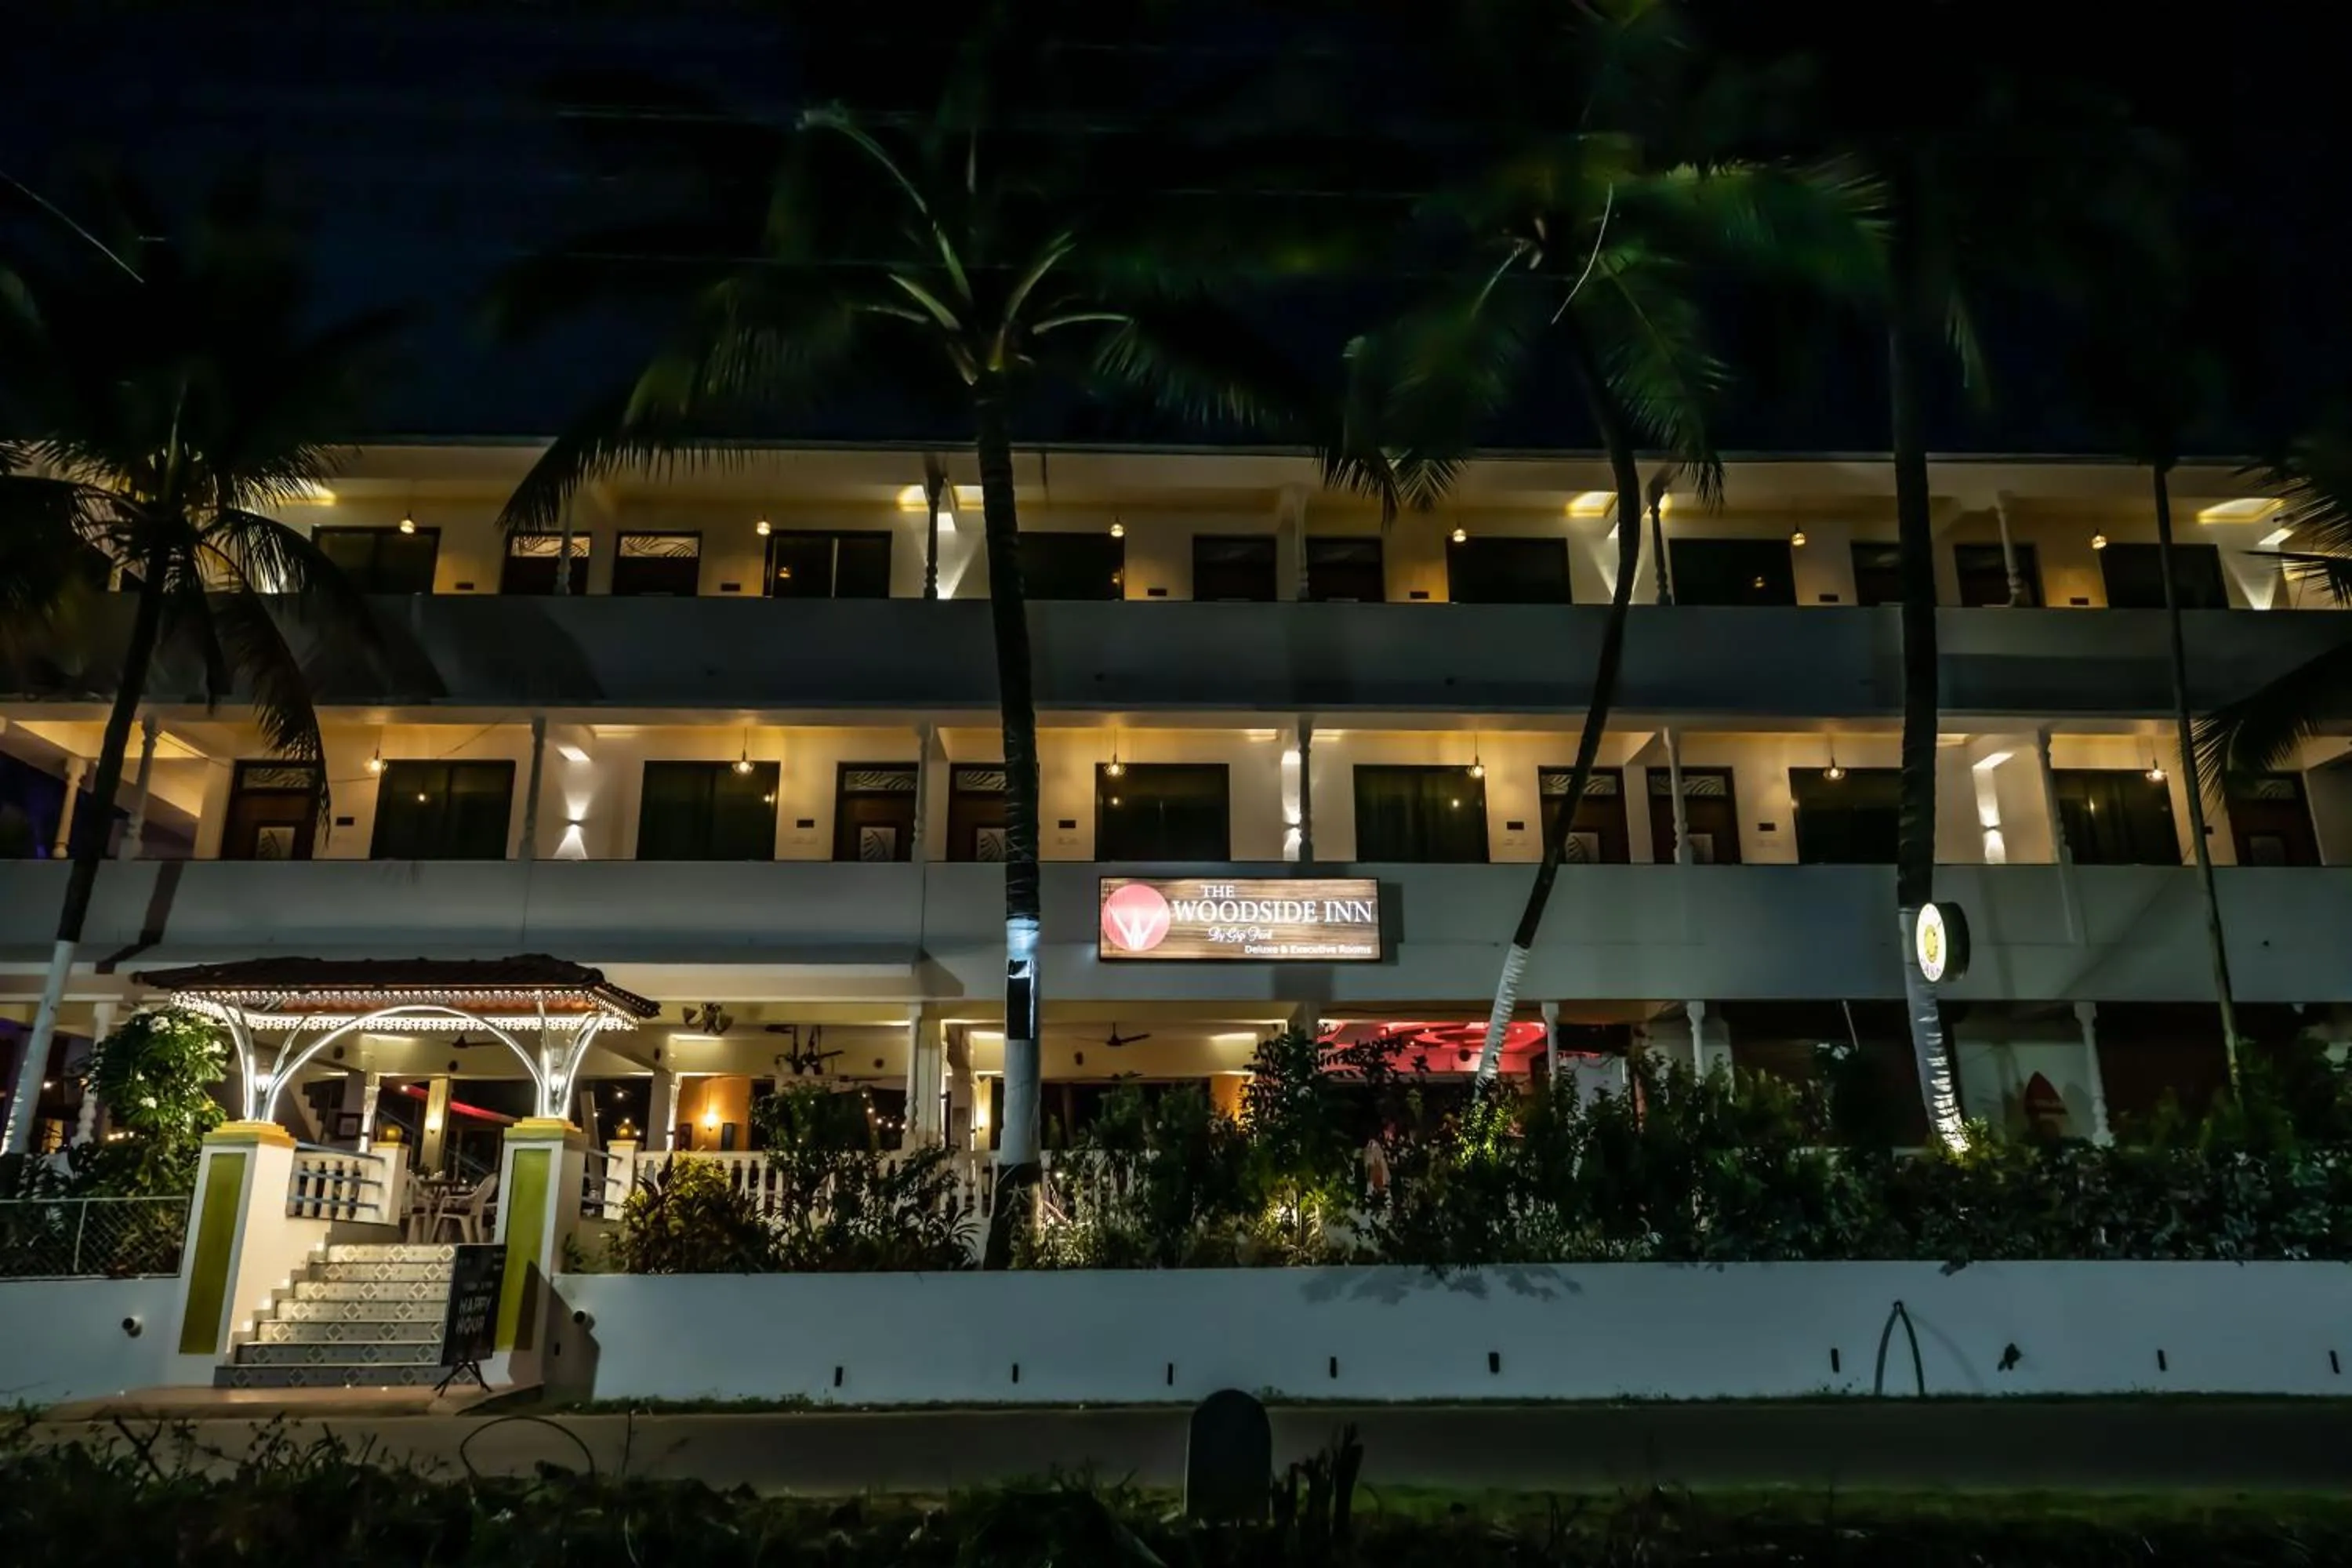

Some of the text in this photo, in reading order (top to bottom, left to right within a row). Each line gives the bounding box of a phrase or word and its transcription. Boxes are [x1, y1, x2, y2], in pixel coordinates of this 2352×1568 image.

[1200, 884, 1235, 898] THE
[1171, 900, 1374, 923] WOODSIDE INN
[1244, 945, 1279, 954] Deluxe
[1338, 944, 1372, 954] Rooms
